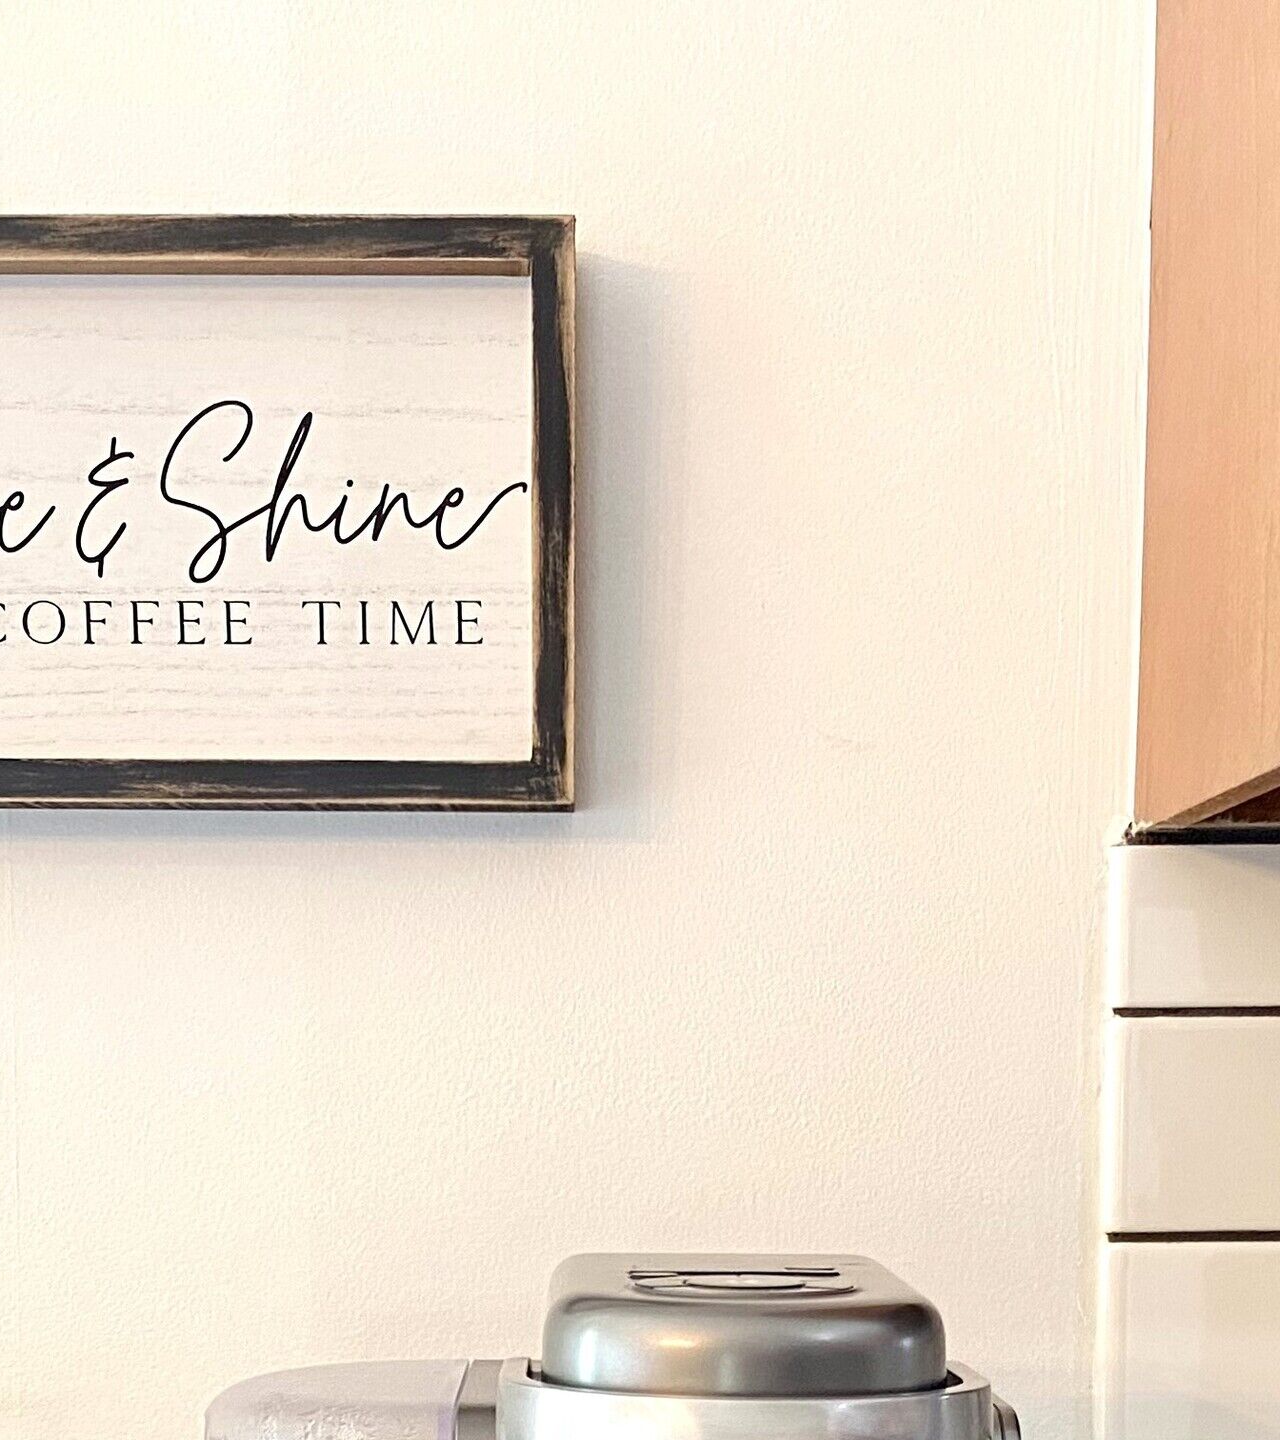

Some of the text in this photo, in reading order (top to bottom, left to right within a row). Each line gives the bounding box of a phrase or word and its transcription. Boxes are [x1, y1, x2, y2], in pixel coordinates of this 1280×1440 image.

[76, 437, 134, 578] &
[161, 400, 527, 584] Shine
[302, 600, 484, 645] TIME
